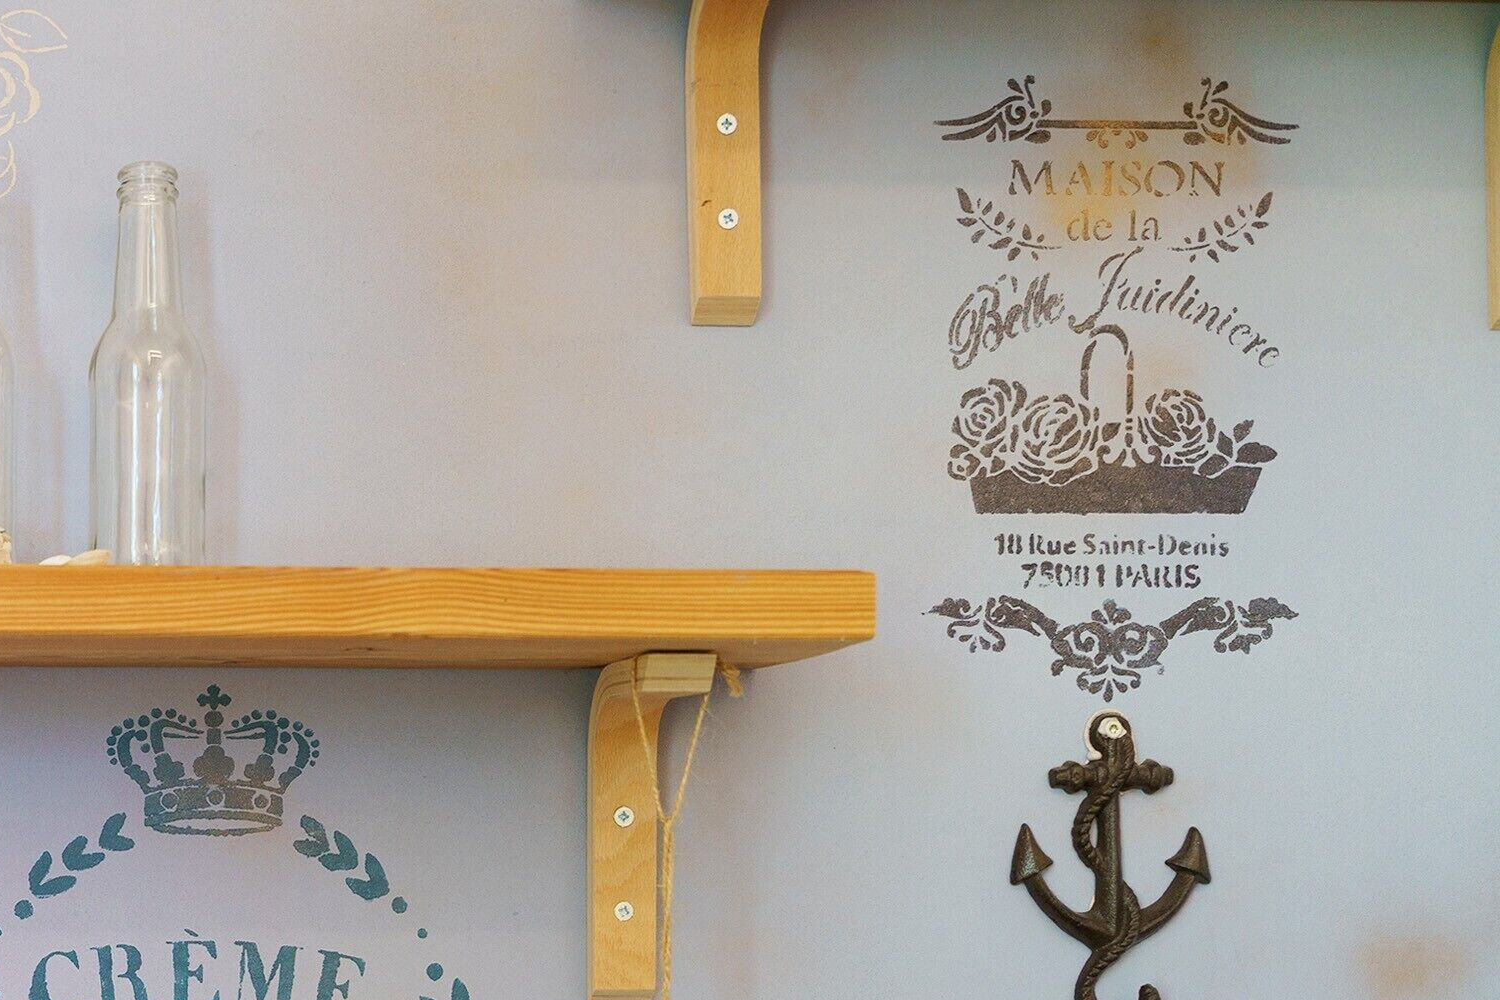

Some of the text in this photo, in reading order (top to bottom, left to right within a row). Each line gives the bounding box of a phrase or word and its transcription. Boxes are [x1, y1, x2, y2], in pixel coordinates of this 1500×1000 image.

[1008, 159, 1225, 197] MAISON
[1066, 208, 1162, 242] de la
[994, 533, 1230, 558] 18 Rue Saint-Denis
[1116, 563, 1201, 589] PARIS
